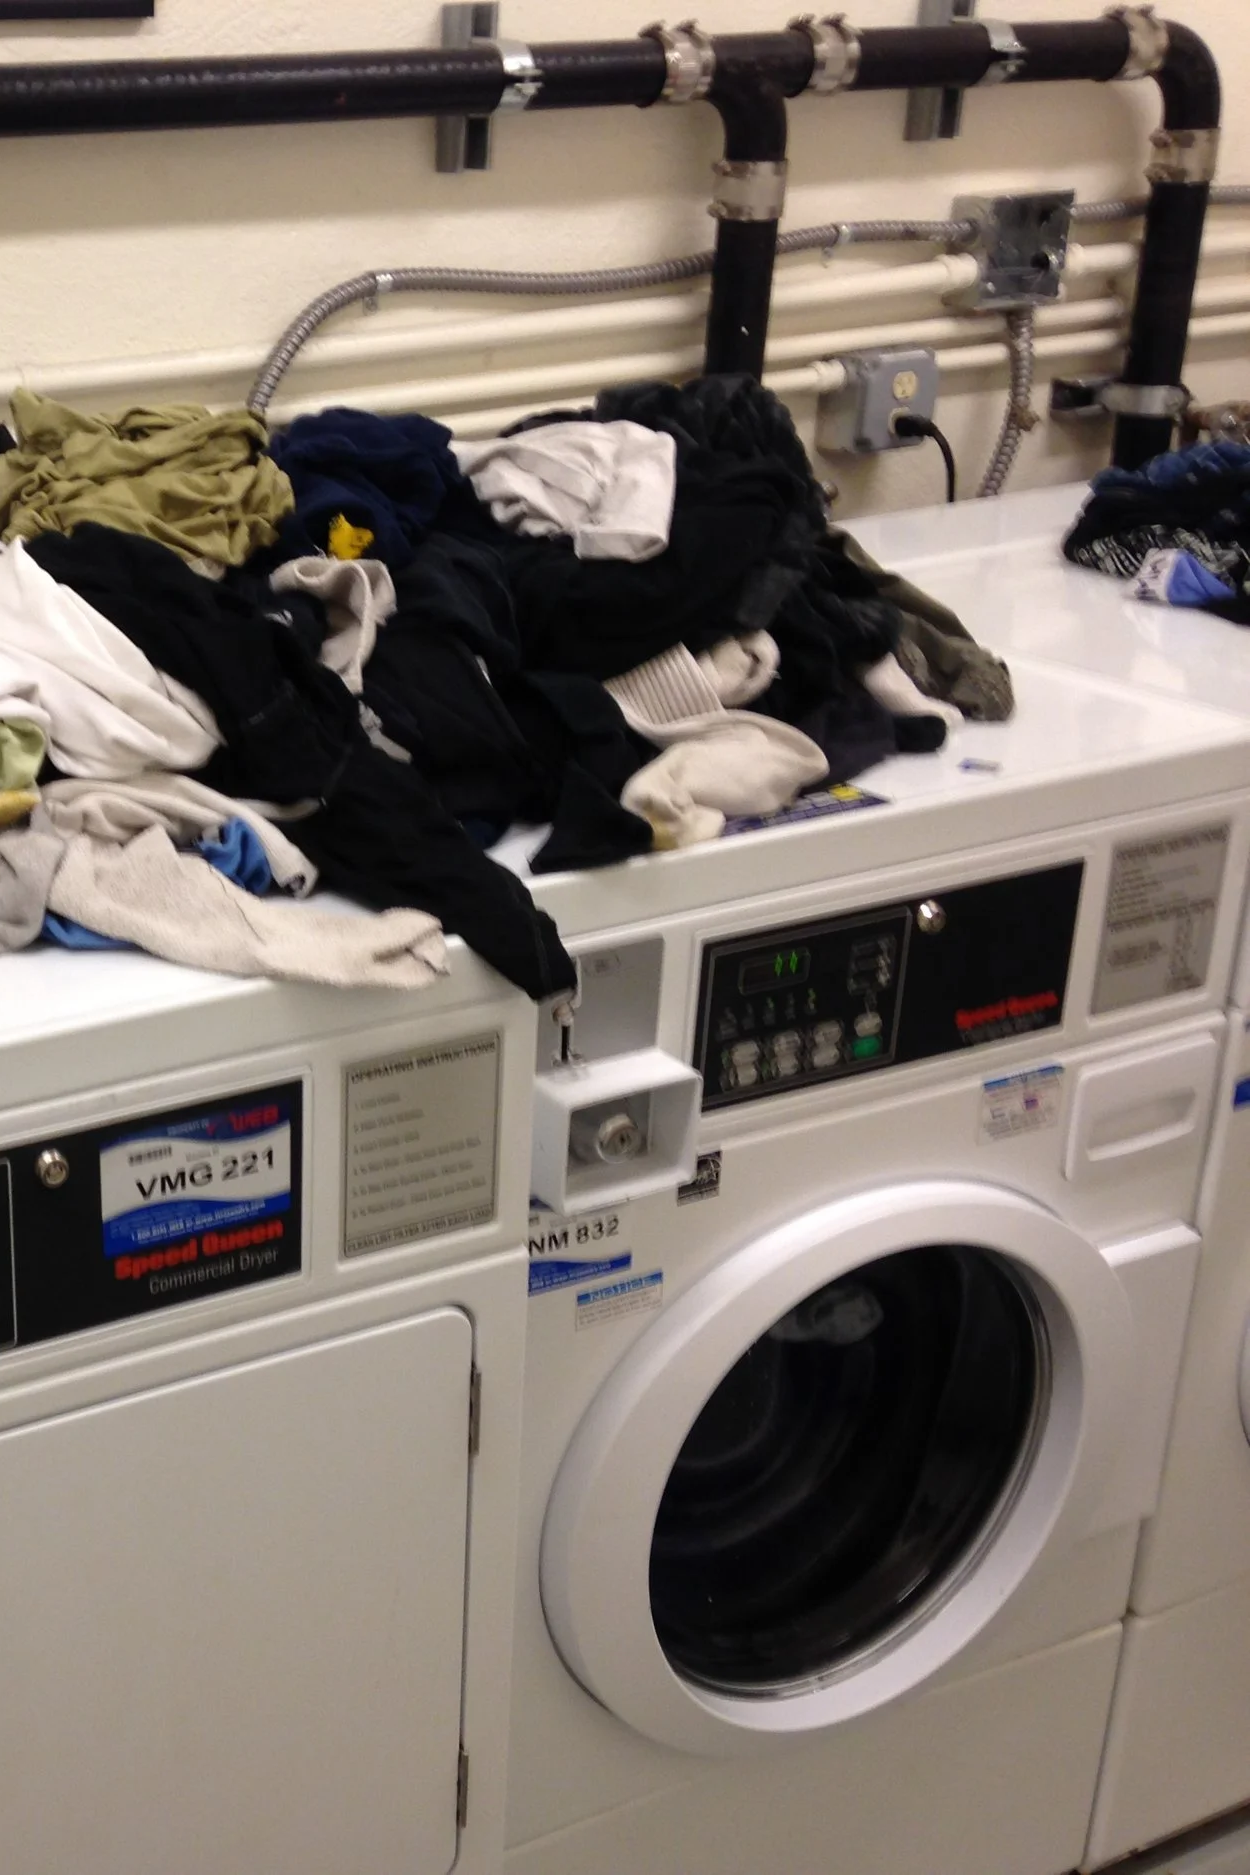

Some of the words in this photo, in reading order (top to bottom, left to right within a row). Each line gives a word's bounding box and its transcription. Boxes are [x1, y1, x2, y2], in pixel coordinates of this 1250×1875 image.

[136, 1162, 213, 1200] VMG
[221, 1147, 274, 1181] 221
[114, 1238, 198, 1280] Speed
[202, 1219, 284, 1256] Queen
[577, 1214, 620, 1245] 832
[149, 1257, 236, 1295] Commercial
[239, 1247, 279, 1268] Dryer
